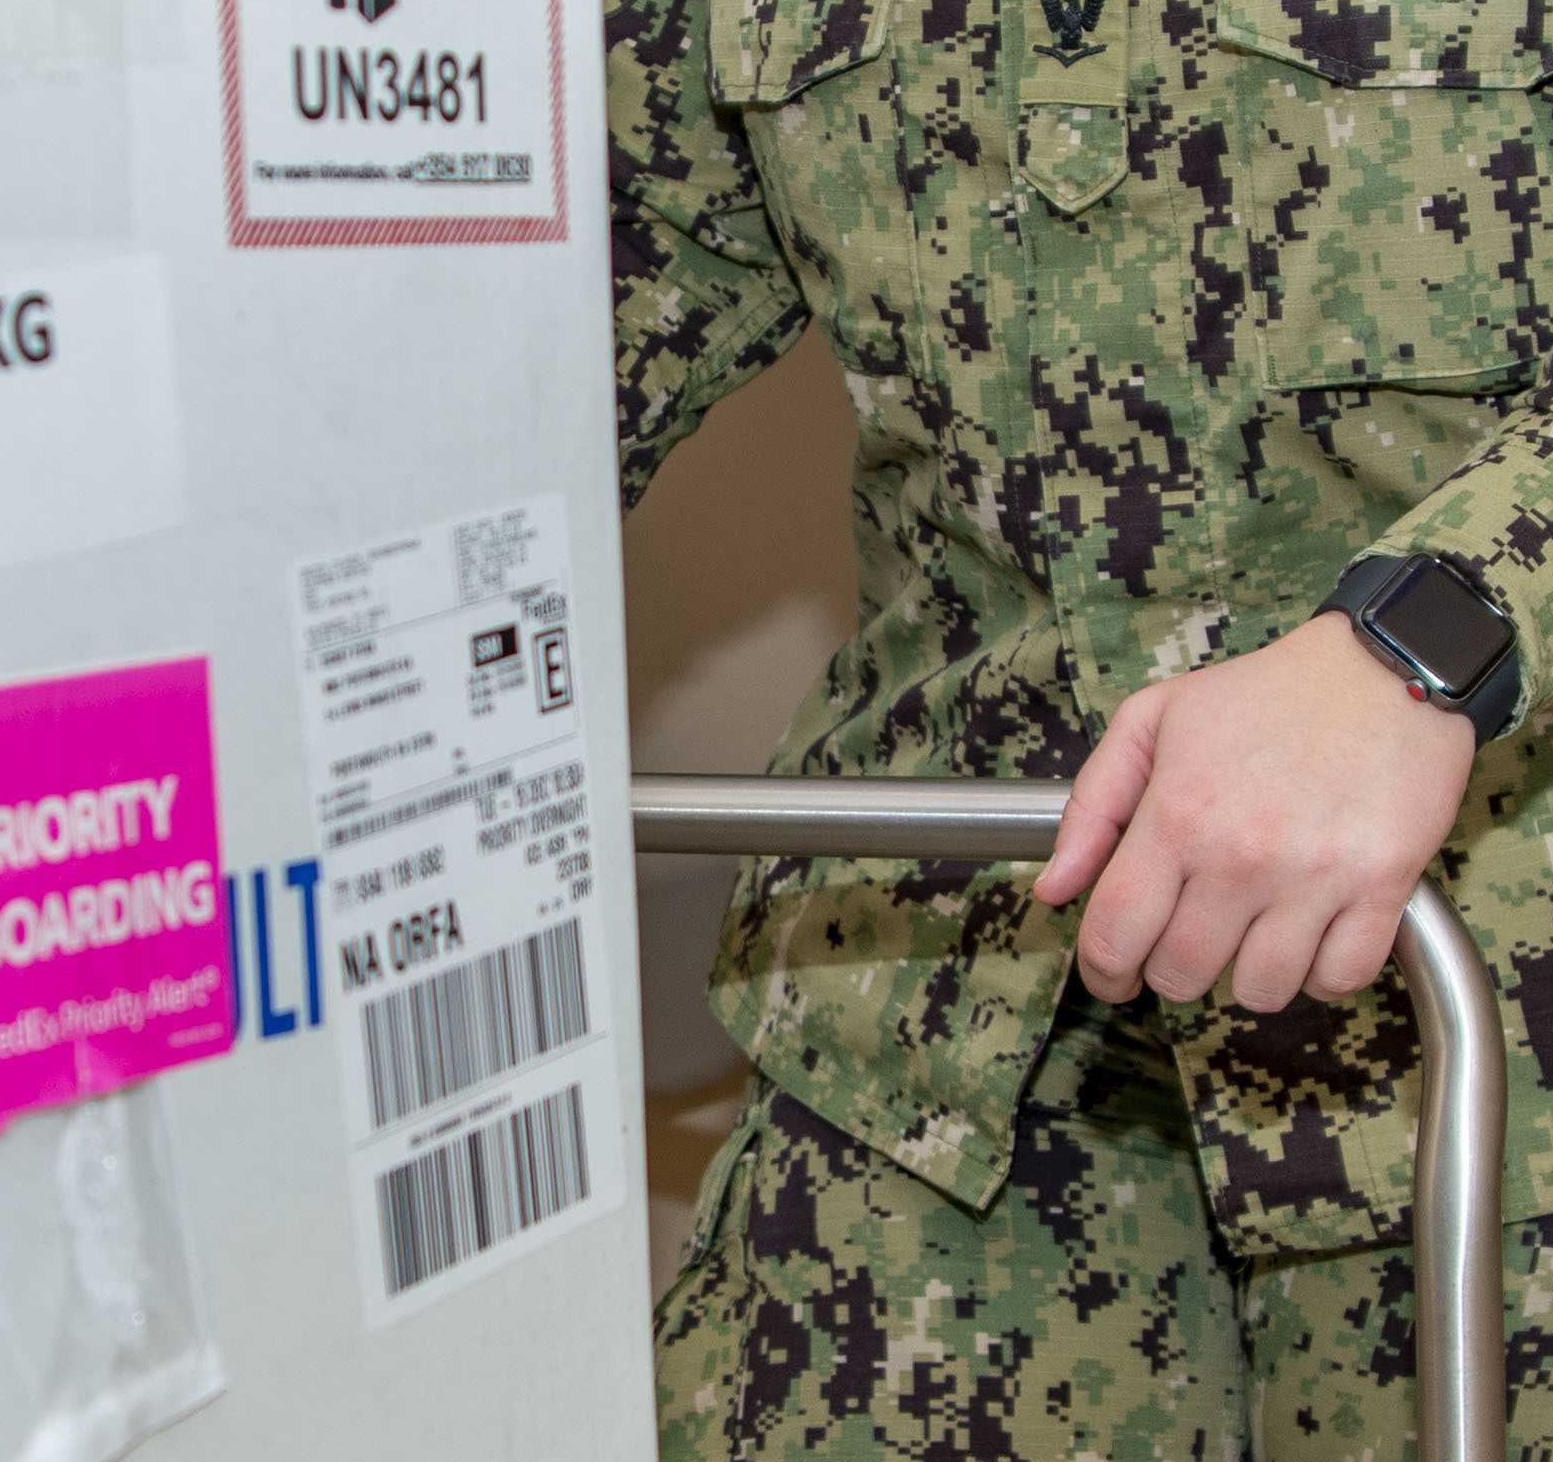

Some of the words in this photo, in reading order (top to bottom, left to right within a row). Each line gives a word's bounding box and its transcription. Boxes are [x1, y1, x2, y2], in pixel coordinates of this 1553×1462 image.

[293, 45, 490, 124] UN3481
[387, 899, 465, 975] ORFA
[58, 987, 146, 1044] Priority
